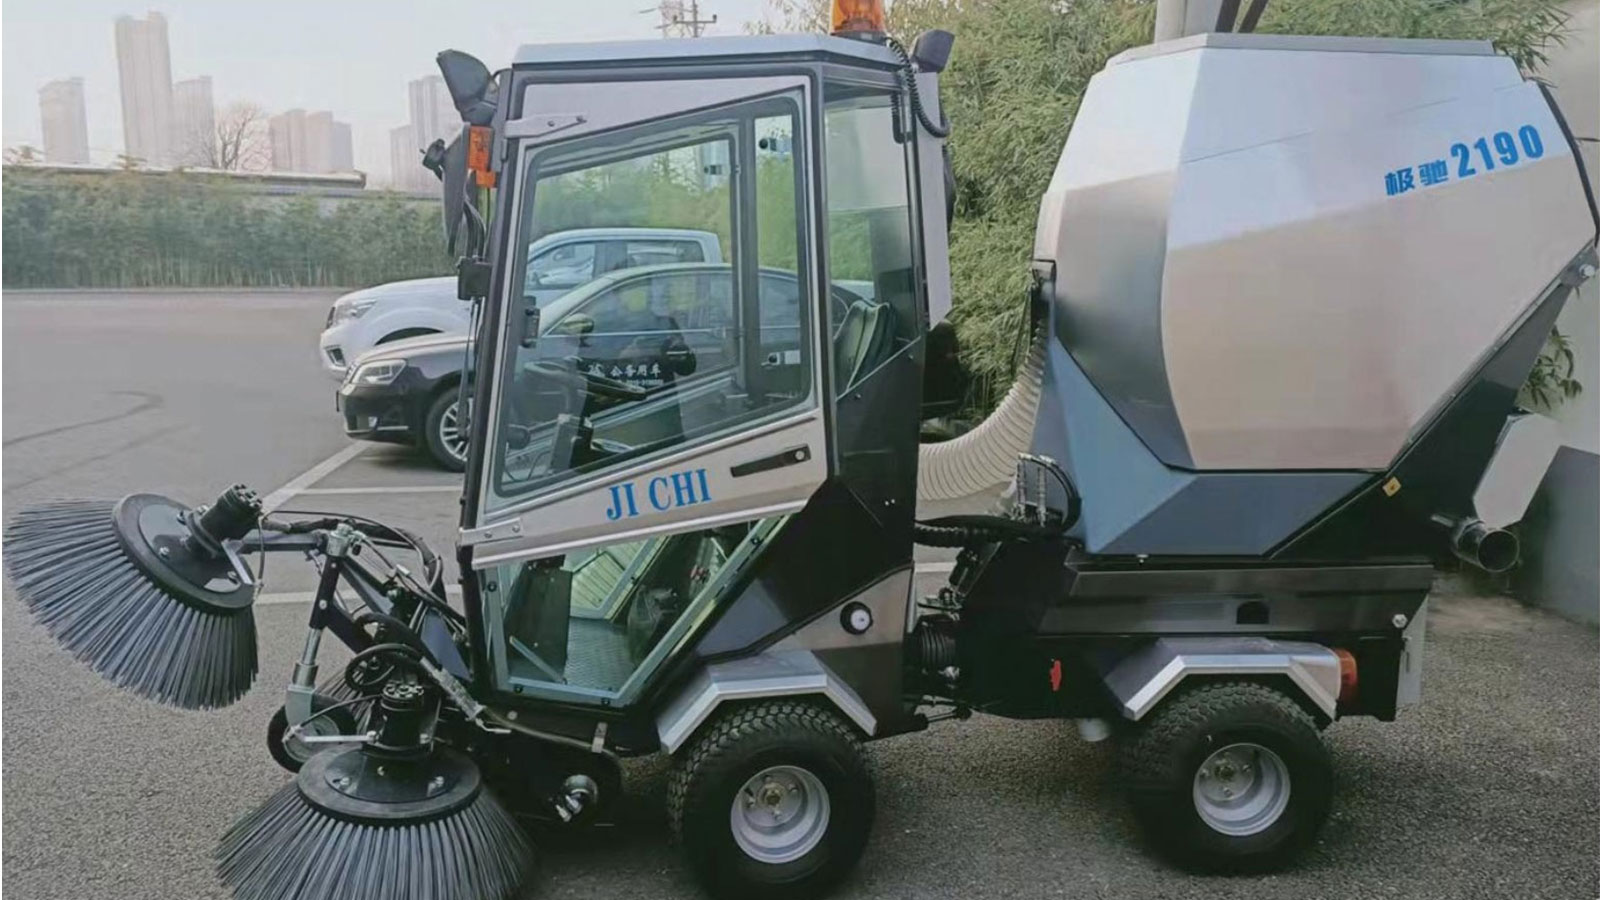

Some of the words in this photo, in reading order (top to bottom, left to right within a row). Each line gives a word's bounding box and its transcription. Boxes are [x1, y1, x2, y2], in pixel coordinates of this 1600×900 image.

[1384, 159, 1449, 196] 极驰
[1450, 124, 1544, 178] 2190
[606, 482, 640, 521] JI
[648, 468, 713, 511] CHI
